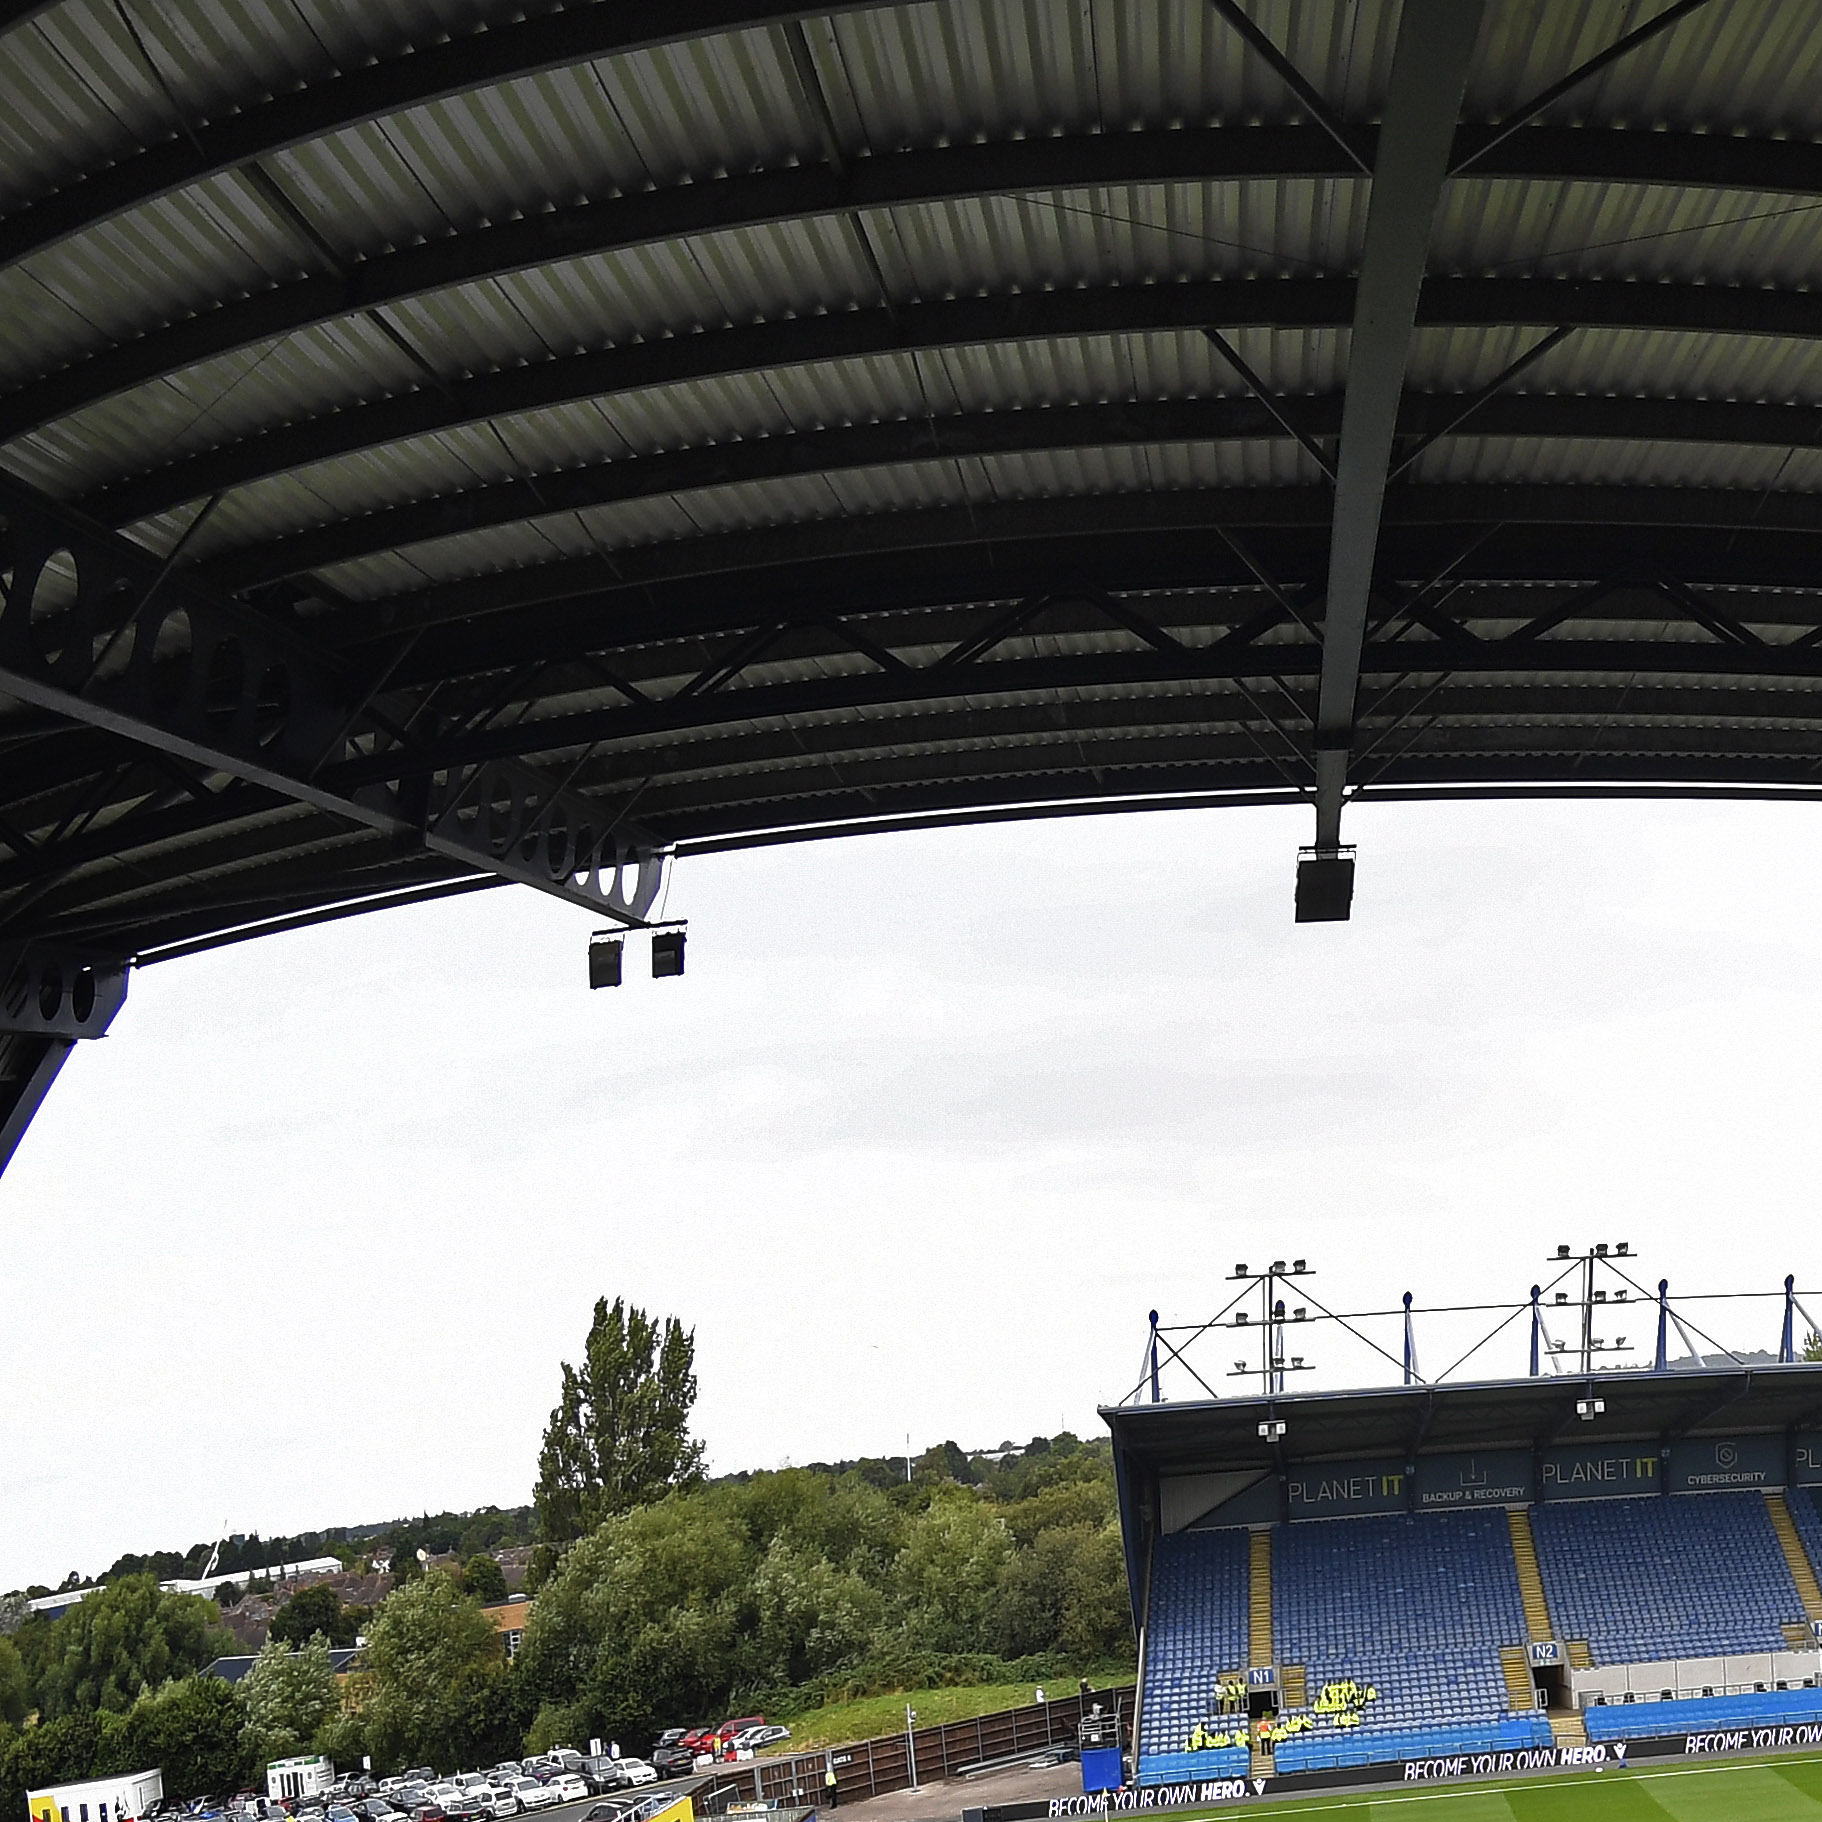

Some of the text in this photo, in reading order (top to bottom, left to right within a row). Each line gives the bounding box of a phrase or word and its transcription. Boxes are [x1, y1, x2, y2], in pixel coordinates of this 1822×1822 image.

[1542, 1457, 1658, 1485] PLANET IT
[1687, 1471, 1766, 1486] CYBERSECURITY
[1288, 1474, 1404, 1503] PLANET IT
[1422, 1490, 1463, 1503] BACKUP
[1473, 1486, 1525, 1500] RECOVERY
[1536, 1645, 1554, 1659] N2
[1253, 1669, 1269, 1684] N1
[1685, 1730, 1749, 1755] BECOME
[1750, 1726, 1794, 1749] YOUR
[1404, 1744, 1611, 1781] BECOME YOUR OWN HERO.
[1112, 1789, 1154, 1811] YOUR
[1156, 1784, 1198, 1808] OWN
[1199, 1779, 1250, 1802] HERO.
